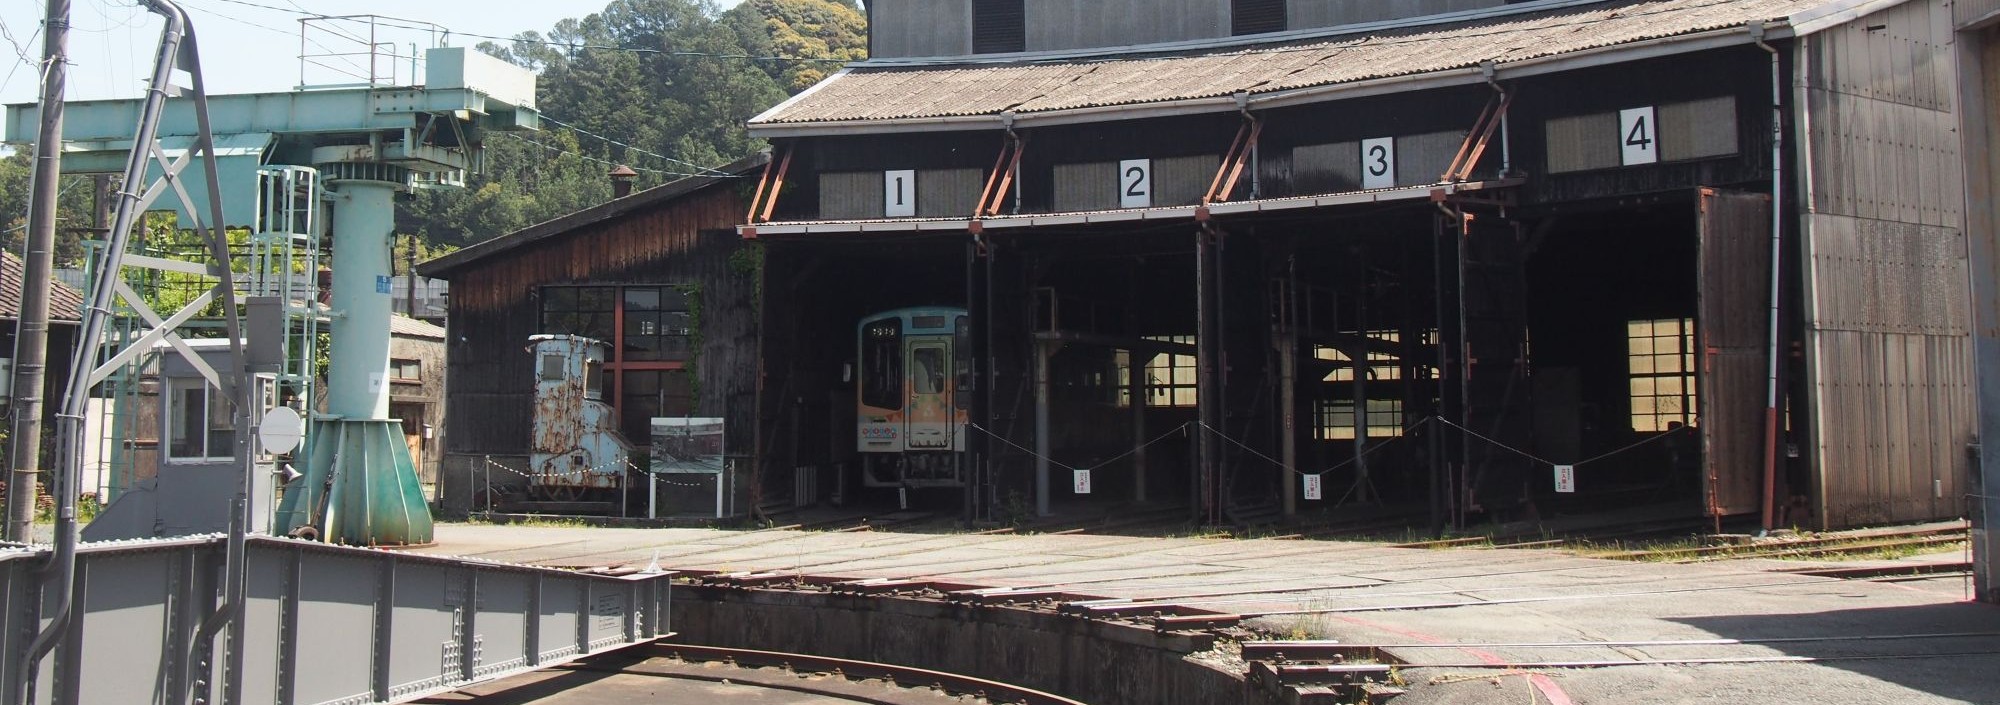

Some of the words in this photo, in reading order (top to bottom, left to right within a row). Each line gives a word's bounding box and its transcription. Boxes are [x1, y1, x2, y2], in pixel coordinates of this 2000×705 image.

[1626, 116, 1651, 150] 4
[1369, 145, 1388, 176] 3
[896, 177, 903, 205] 1
[1125, 167, 1145, 196] 2
